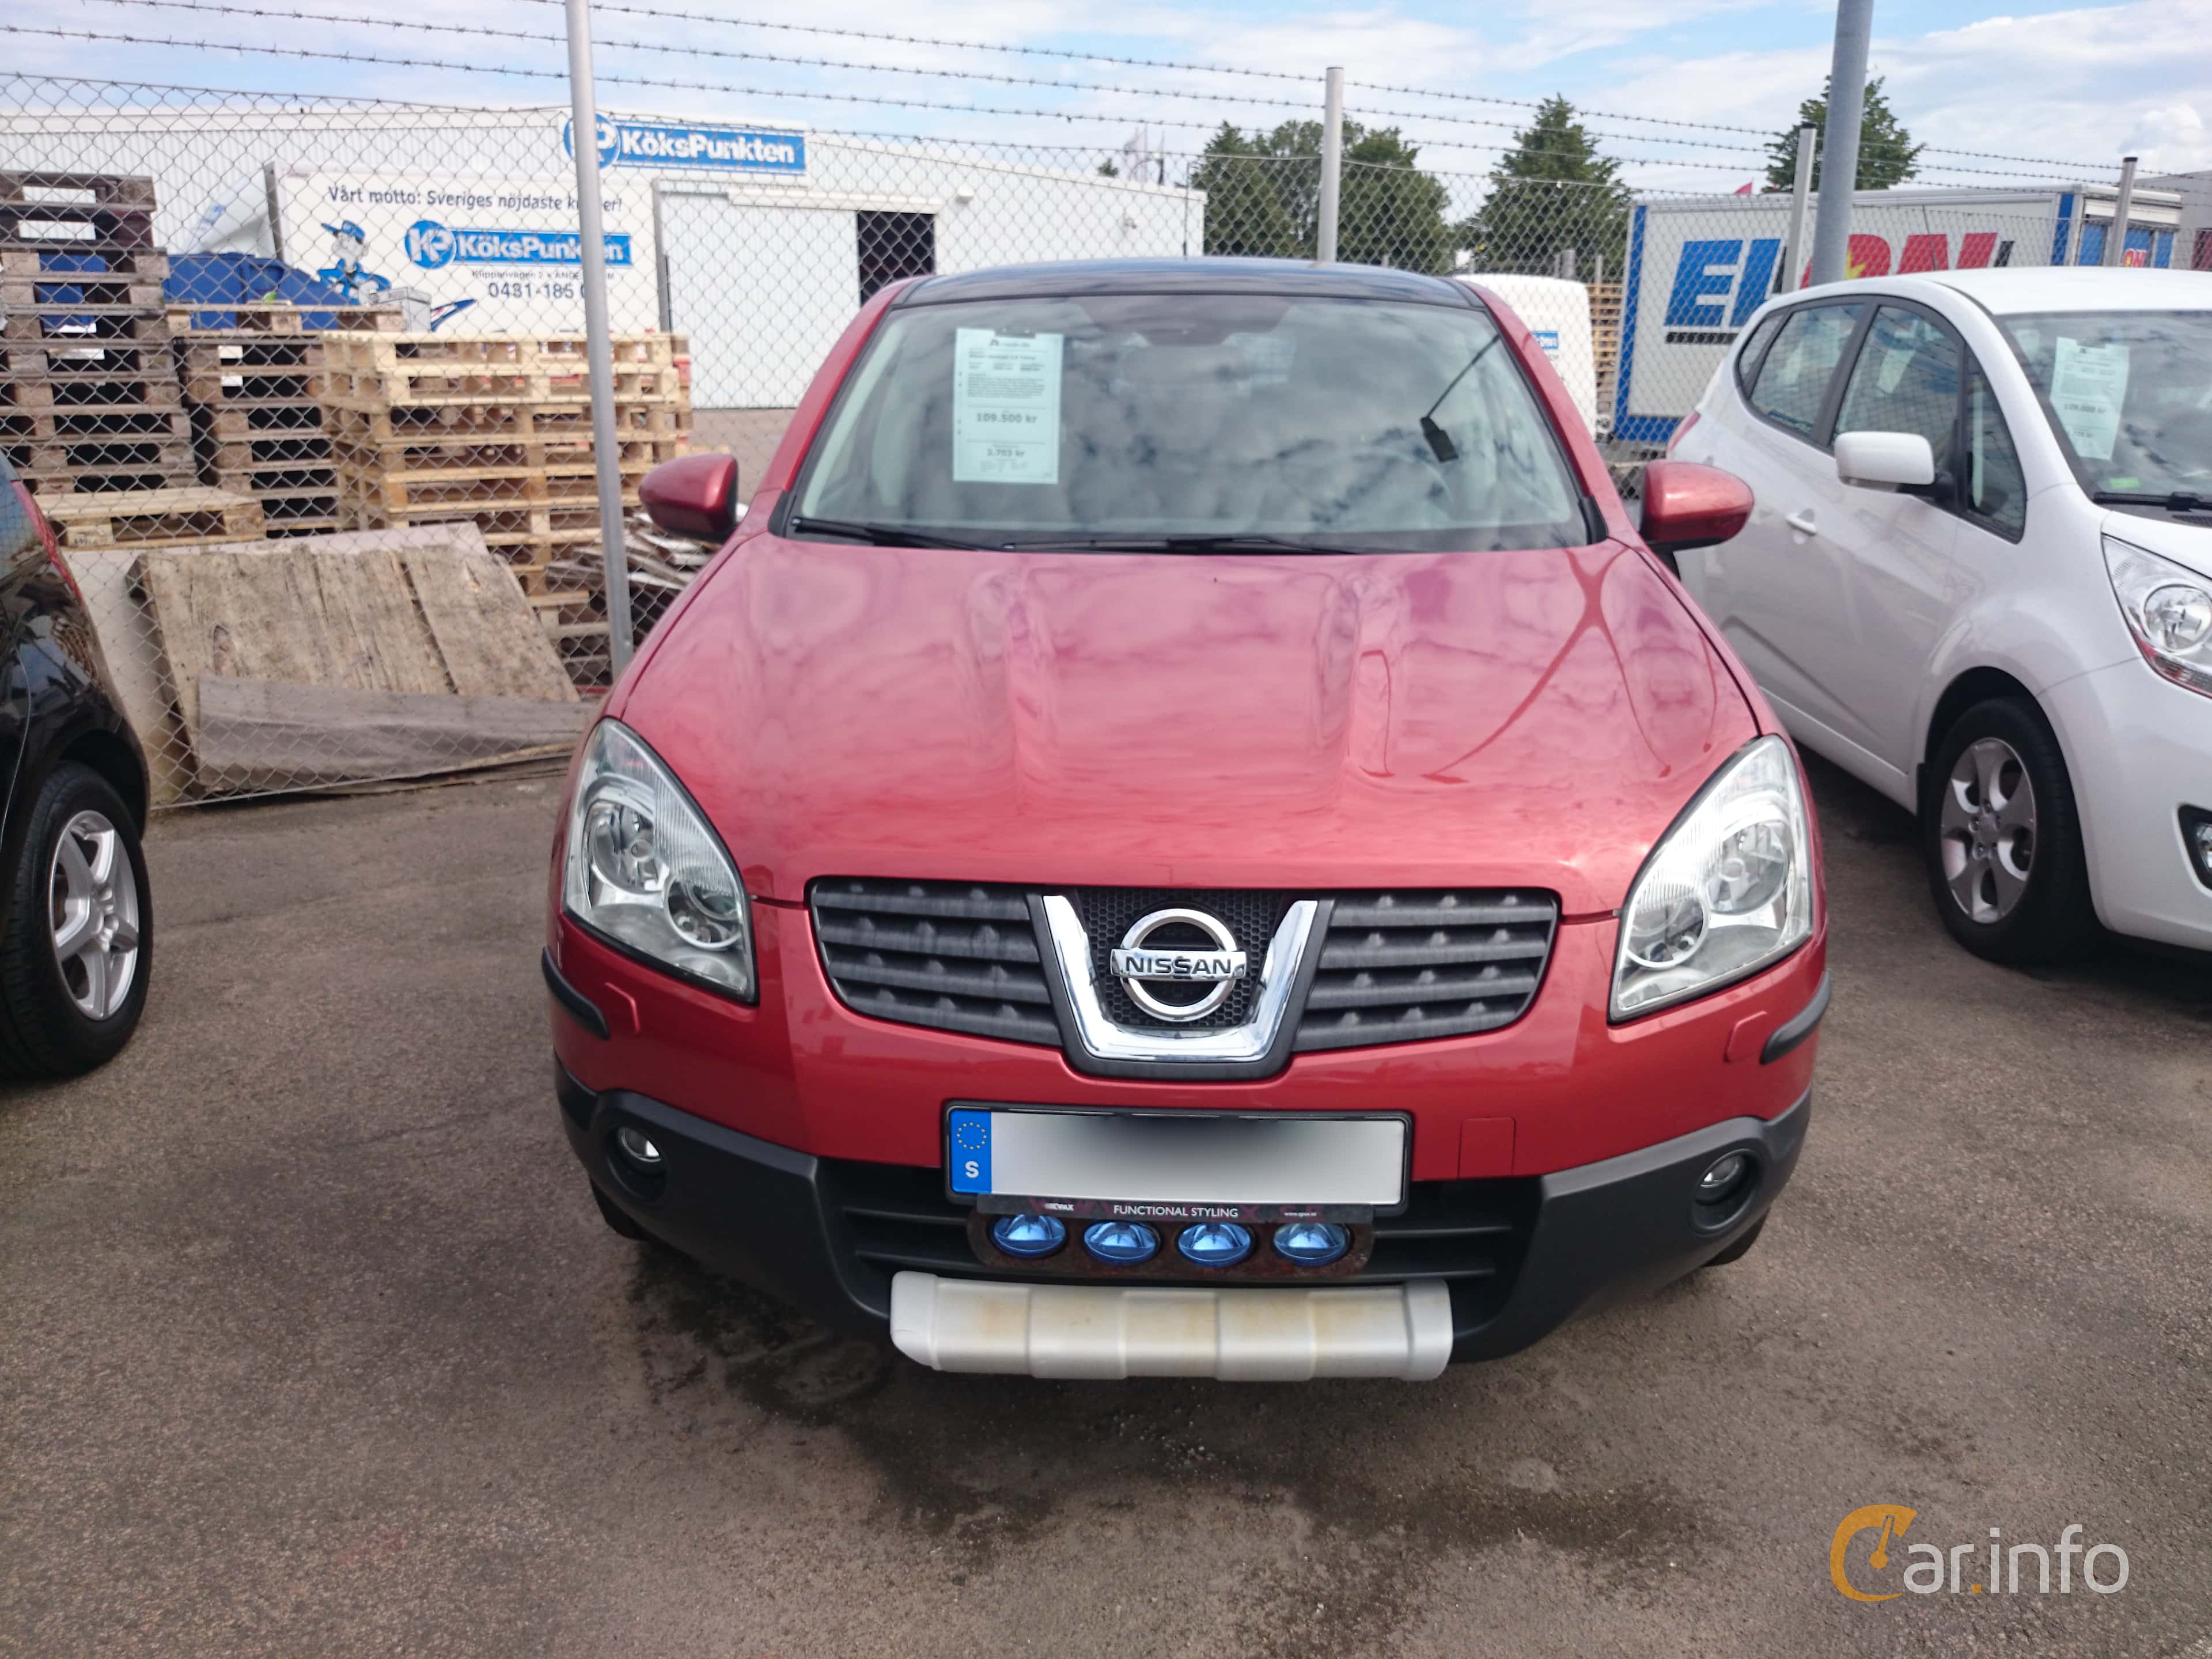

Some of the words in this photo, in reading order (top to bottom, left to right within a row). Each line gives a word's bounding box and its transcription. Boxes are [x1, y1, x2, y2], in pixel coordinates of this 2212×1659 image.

[621, 129, 796, 164] KöksPunkten
[328, 185, 365, 202] Vårt
[369, 189, 421, 204] motto:
[427, 190, 493, 210] Sveriges
[498, 194, 562, 211] nöjdaste
[568, 195, 622, 212] ker!
[460, 234, 624, 260] KöksPunkn
[1126, 956, 1231, 974] NISSAN
[965, 1161, 979, 1178] S
[1113, 1205, 1188, 1216] FUNCTIONAL
[1191, 1207, 1238, 1217] STYLING
